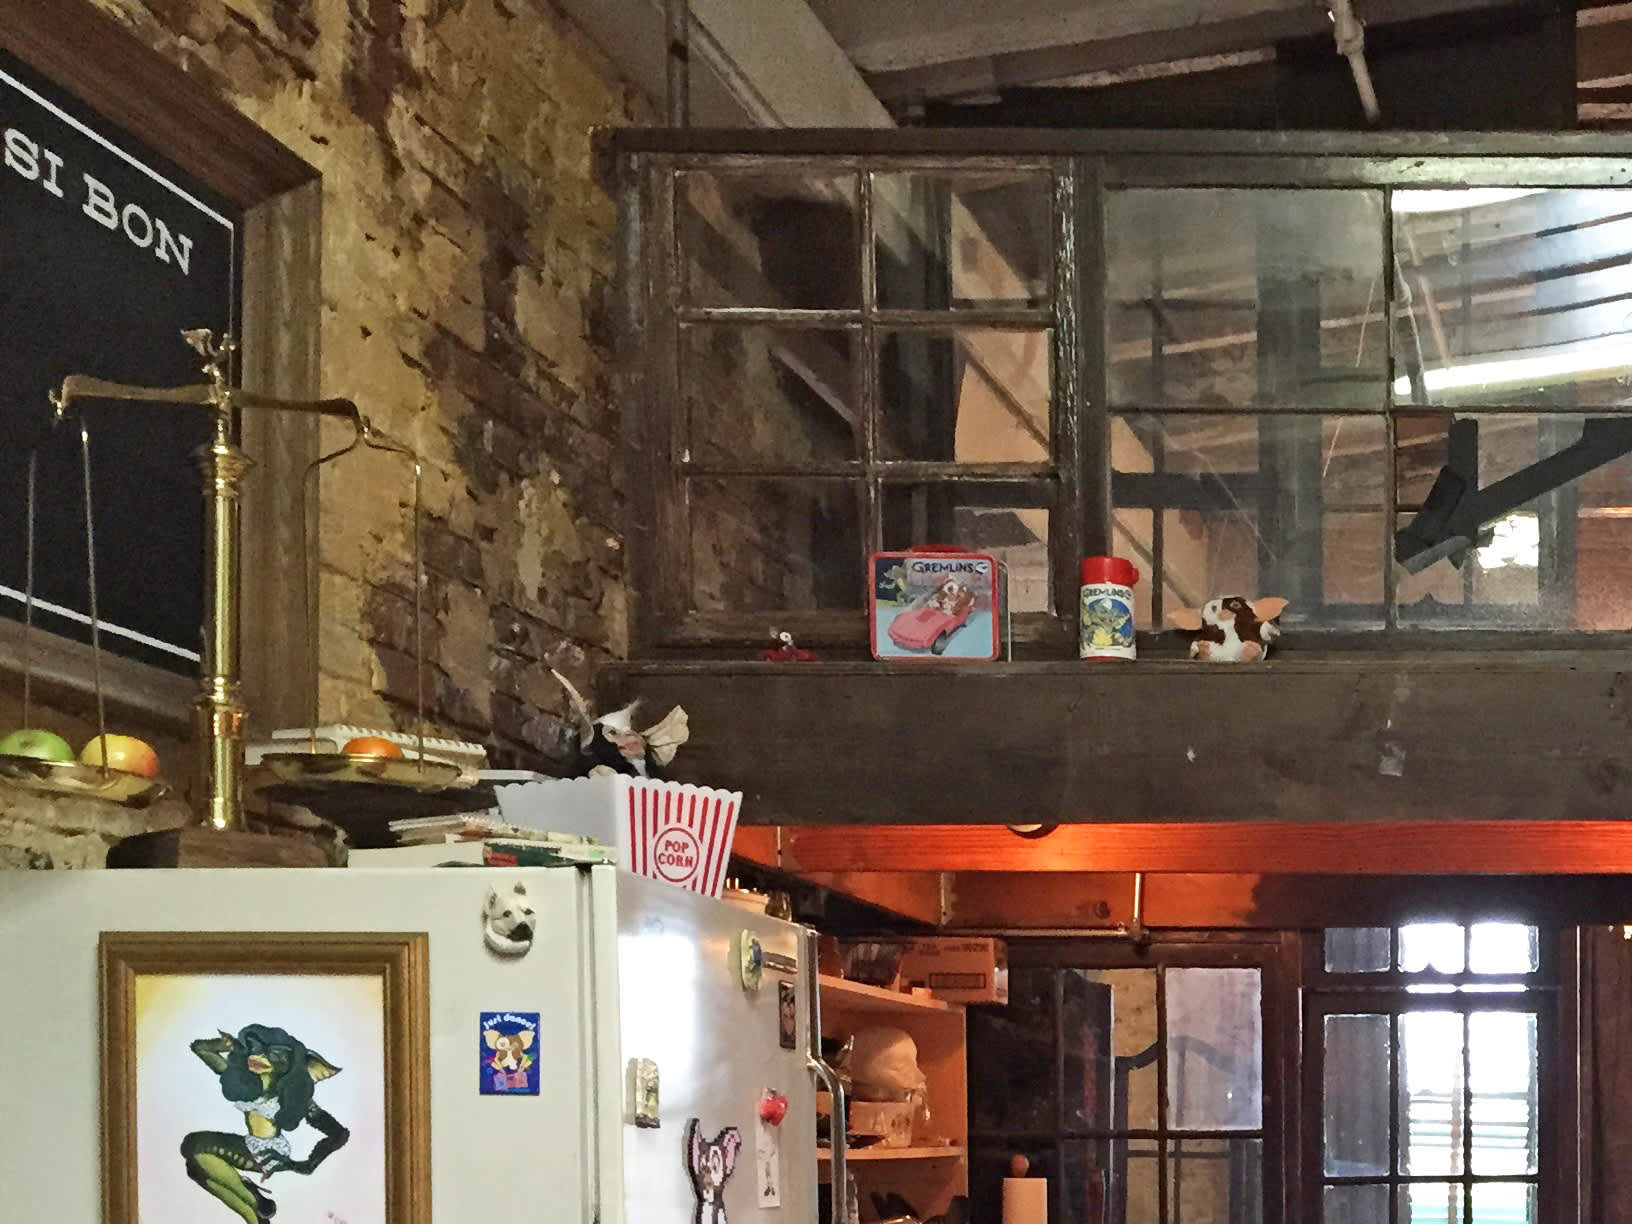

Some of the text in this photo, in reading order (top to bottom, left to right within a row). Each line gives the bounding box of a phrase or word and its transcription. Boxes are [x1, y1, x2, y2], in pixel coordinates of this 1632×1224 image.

[4, 127, 193, 276] SI BON
[911, 561, 974, 574] GREMLINS
[664, 840, 689, 853] POP
[658, 852, 693, 867] CORN
